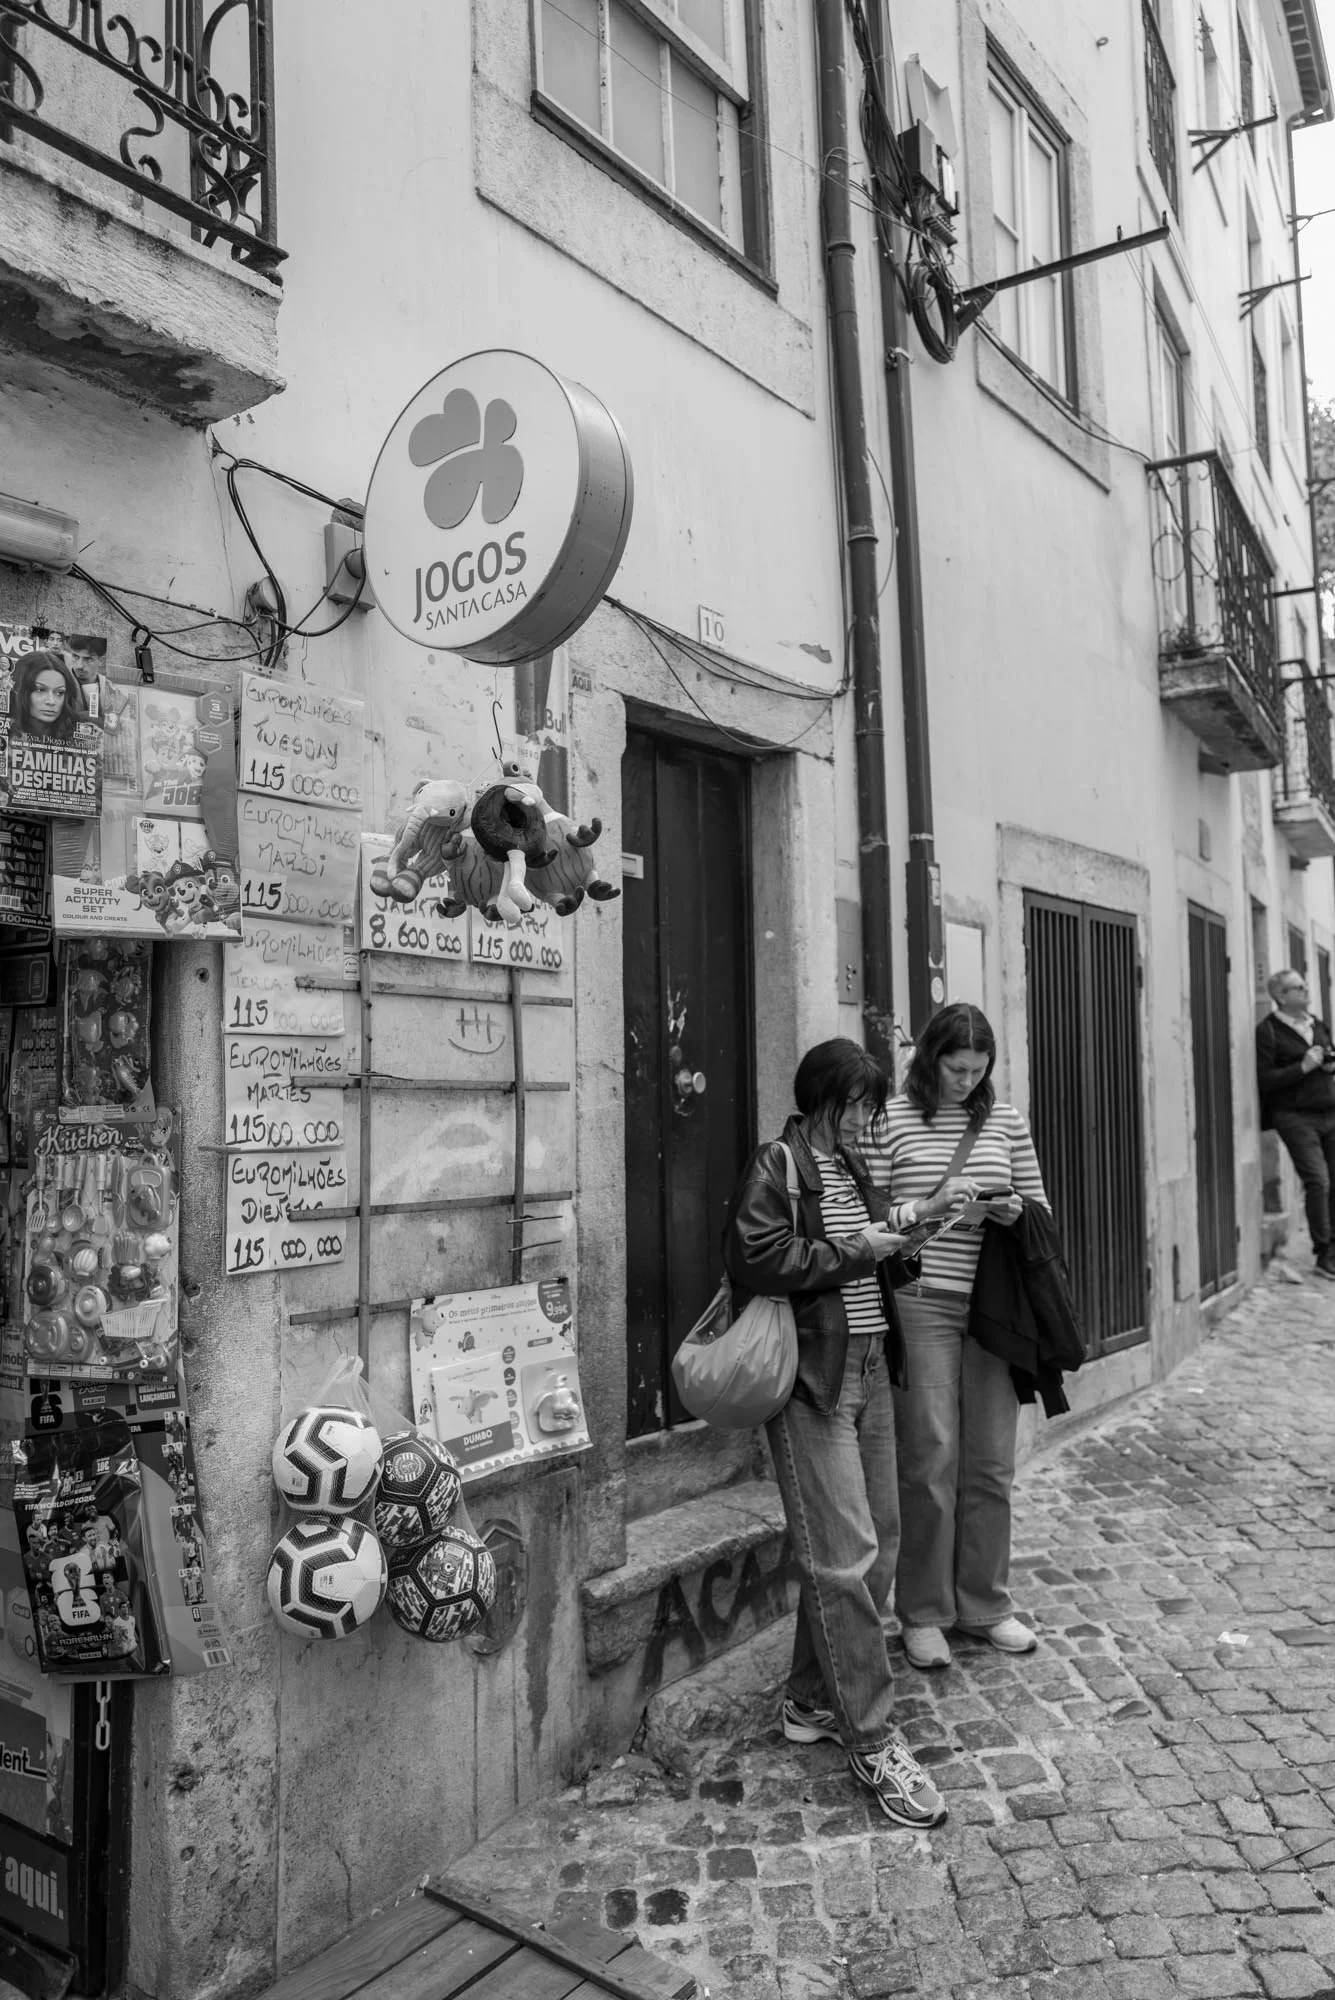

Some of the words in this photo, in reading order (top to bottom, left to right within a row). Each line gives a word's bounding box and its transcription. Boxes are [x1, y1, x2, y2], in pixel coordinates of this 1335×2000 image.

[413, 531, 527, 624] JOGOS
[704, 616, 725, 642] 10
[571, 675, 592, 692] AQUI
[544, 708, 567, 735] Bull
[254, 716, 338, 770] TUESDAY
[12, 748, 96, 777] FAMÍLIAS
[245, 759, 285, 790] 115
[12, 768, 96, 794] DESFEITAS
[64, 896, 121, 906] ACTIVITY
[73, 887, 113, 896] SUPER
[241, 880, 282, 910] 115
[0, 913, 21, 923] 100
[82, 905, 104, 913] SET
[473, 932, 504, 961] 115
[229, 995, 268, 1028] 115
[247, 1082, 311, 1109] MARTES
[34, 1123, 122, 1156] Kitchen
[226, 1113, 266, 1145] 115
[140, 1391, 175, 1404] LANÇAMENTO
[39, 1415, 55, 1425] FIFA
[463, 1429, 493, 1446] DUMBO
[24, 1502, 39, 1511] FIFA
[39, 1500, 64, 1510] WORLD
[75, 1494, 96, 1504] 2026
[72, 1610, 90, 1619] FIFA
[59, 1633, 113, 1646] ADRENALYN
[5, 1856, 65, 1921] aqui.
